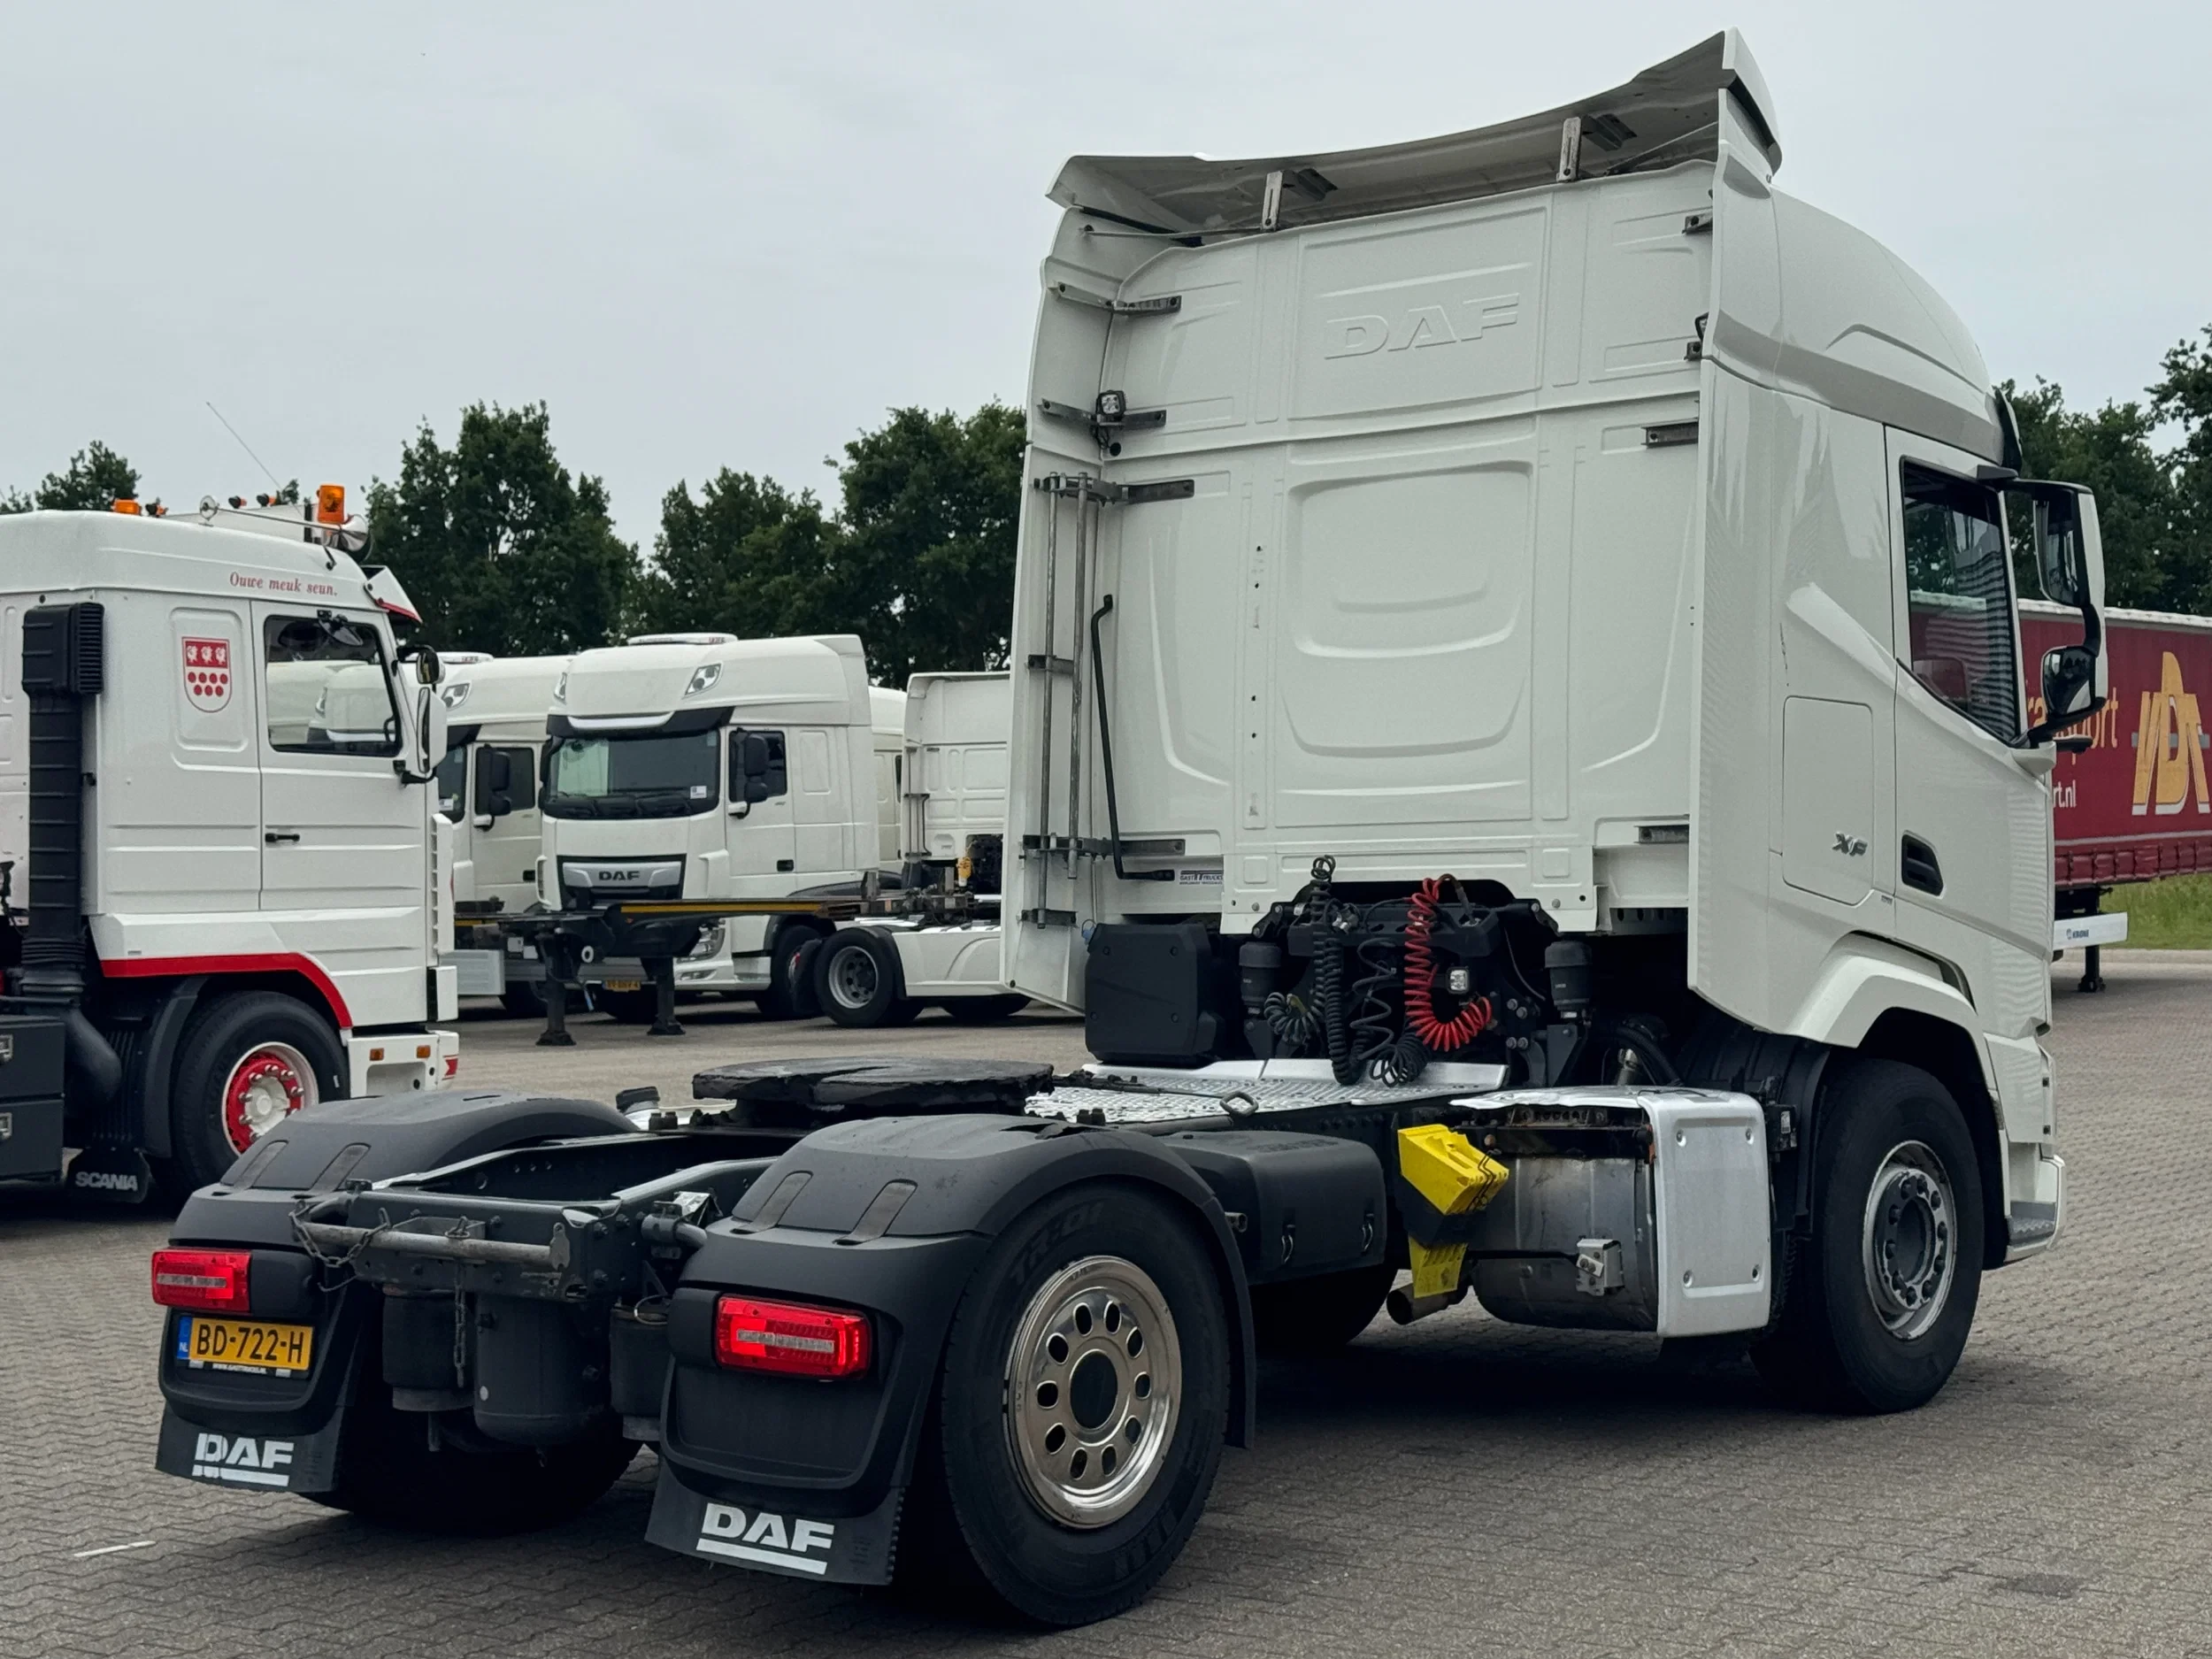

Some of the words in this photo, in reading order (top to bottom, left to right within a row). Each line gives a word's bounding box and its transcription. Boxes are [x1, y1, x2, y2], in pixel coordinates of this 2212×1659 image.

[1324, 292, 1520, 360] DAF
[1832, 832, 1869, 856] XF
[598, 871, 640, 881] DAF
[75, 1171, 138, 1192] SCANIA
[179, 1341, 188, 1353] NL
[196, 1324, 304, 1363] BD-722-H
[195, 1432, 295, 1469] DAF
[702, 1502, 834, 1552] DAF
